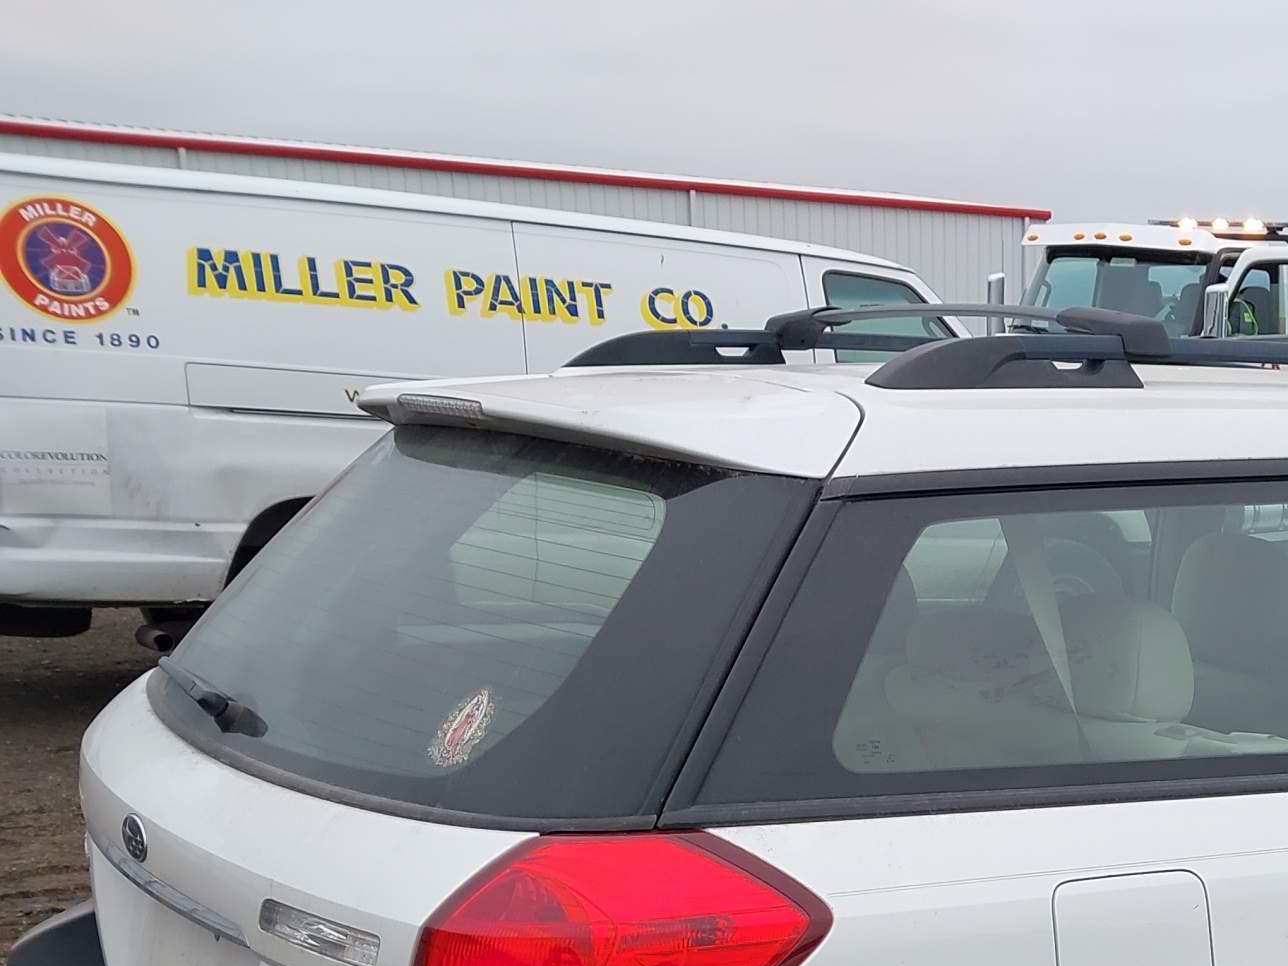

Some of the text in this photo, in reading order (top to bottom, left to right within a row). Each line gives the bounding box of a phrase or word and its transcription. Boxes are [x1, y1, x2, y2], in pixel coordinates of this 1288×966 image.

[18, 202, 97, 227] MILLER
[191, 247, 419, 308] MILLER
[446, 269, 612, 323] PAINT
[33, 293, 110, 317] PAINTS
[95, 331, 160, 349] 1890
